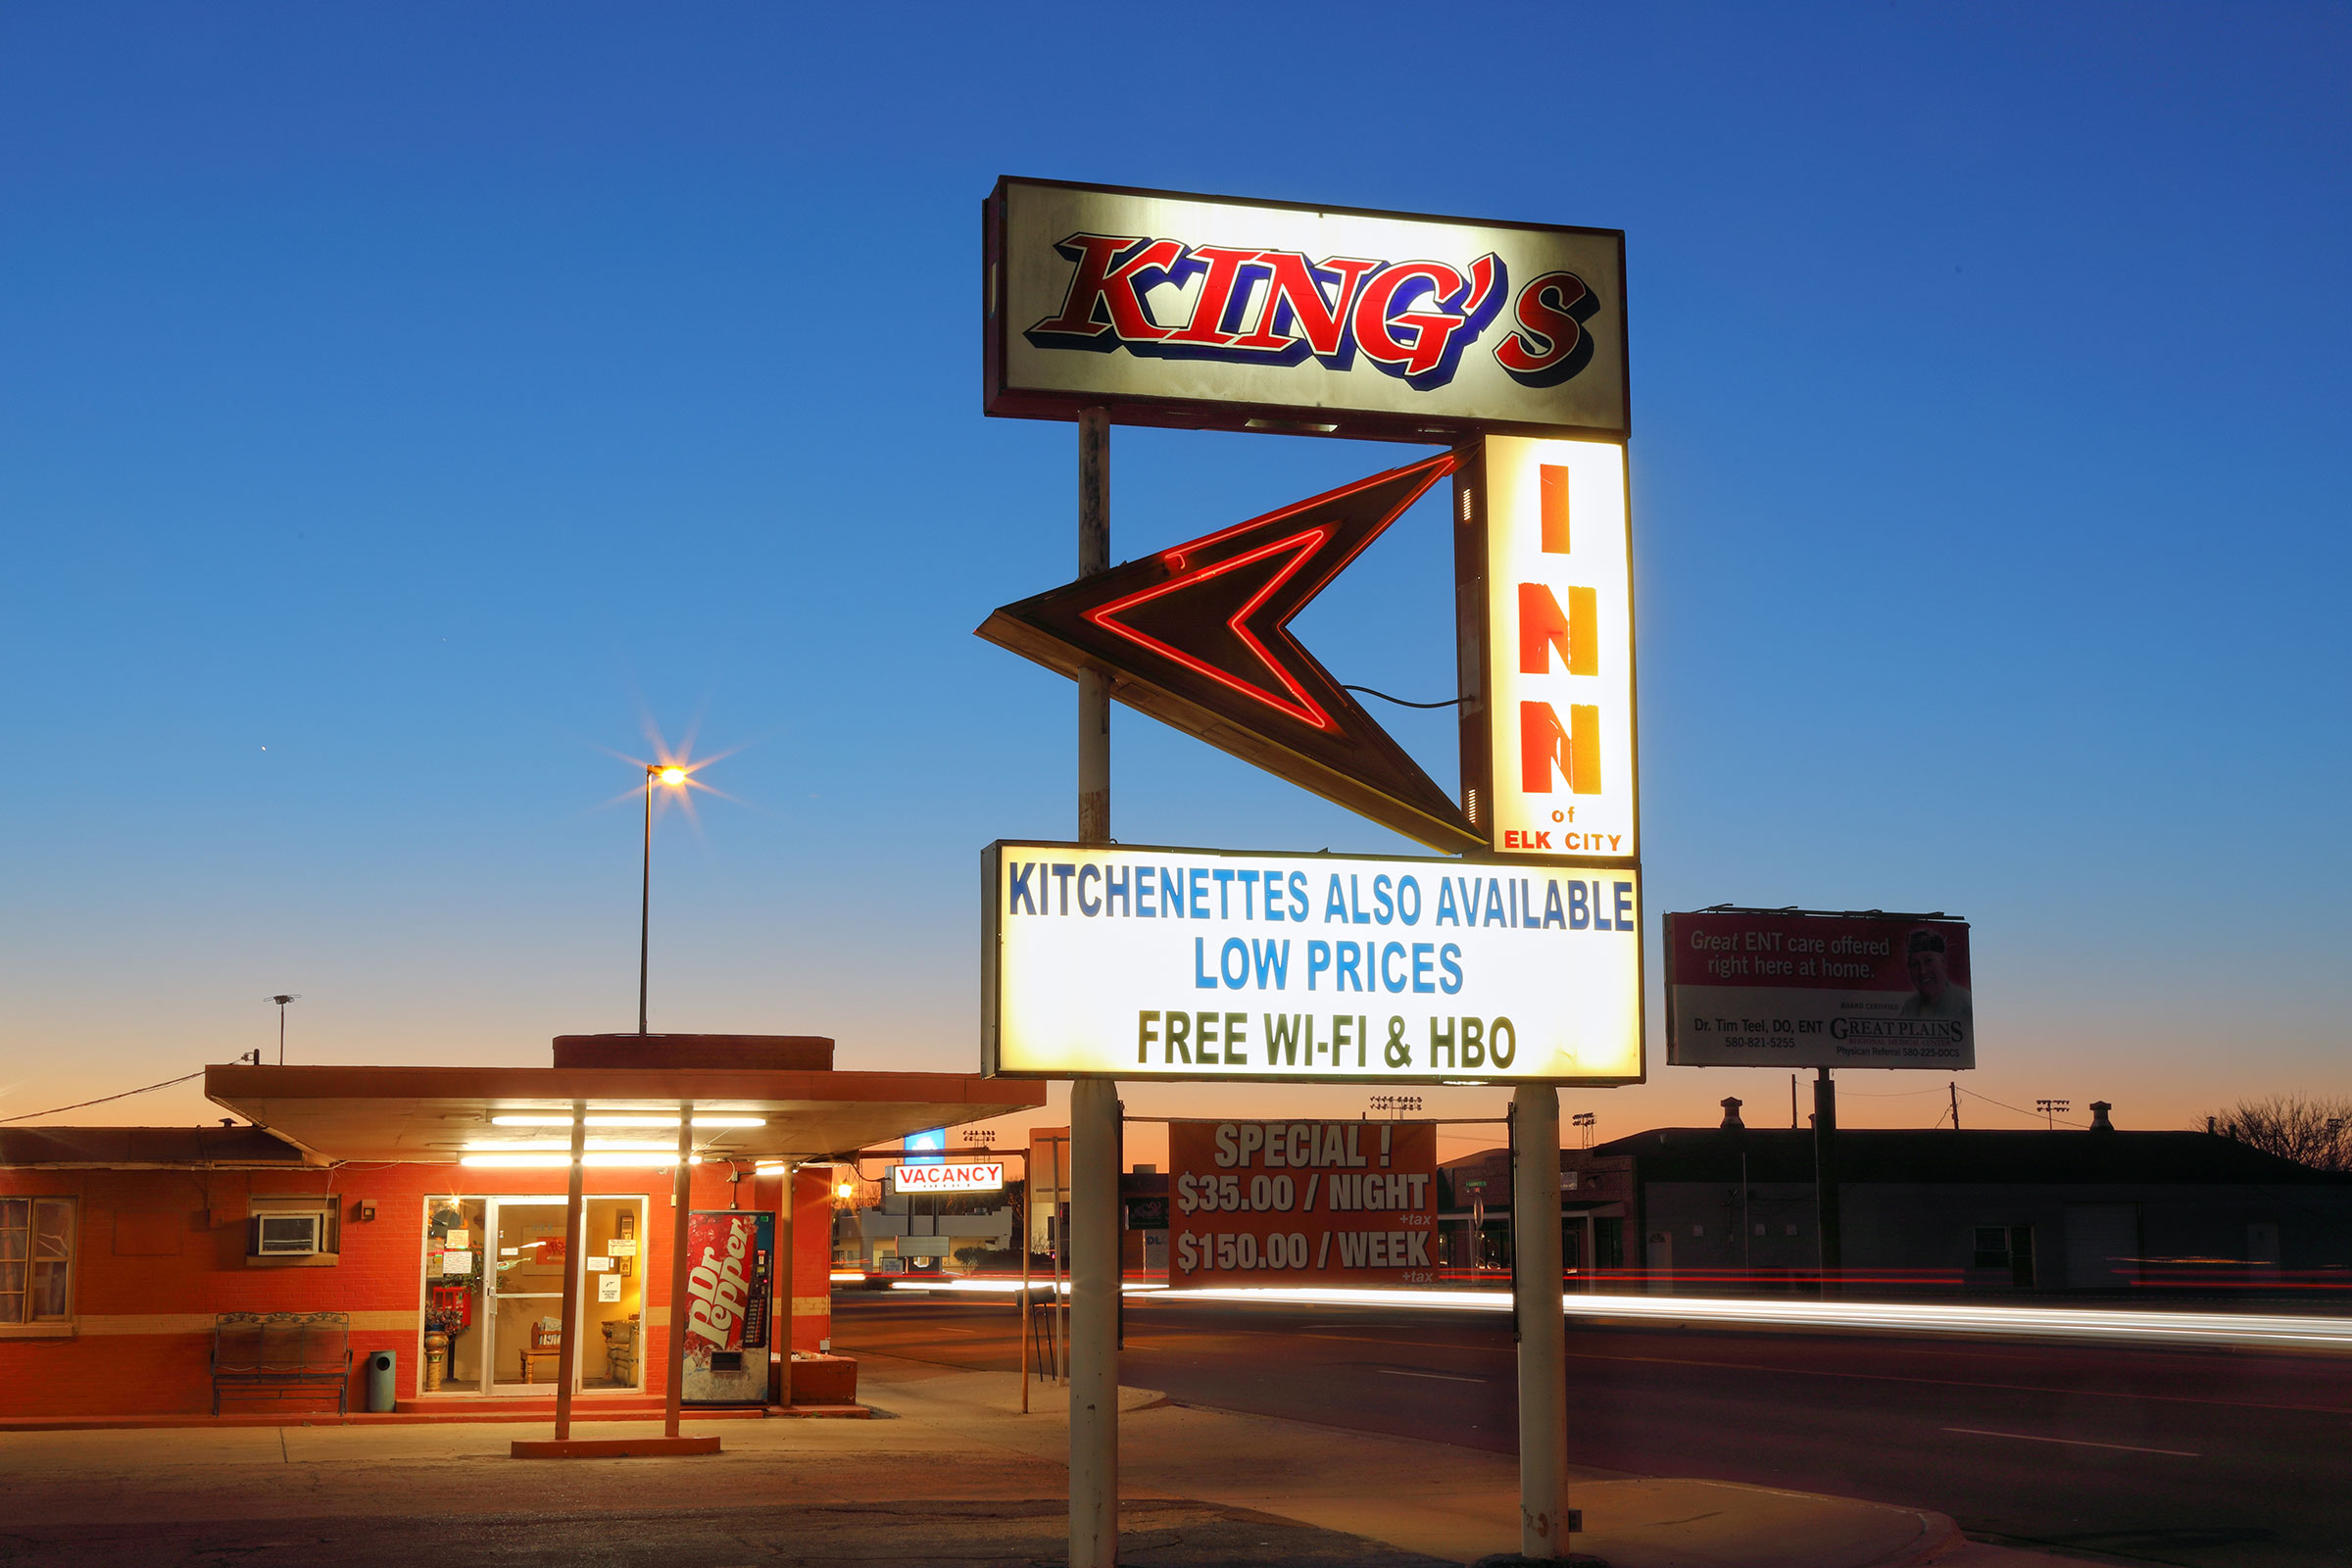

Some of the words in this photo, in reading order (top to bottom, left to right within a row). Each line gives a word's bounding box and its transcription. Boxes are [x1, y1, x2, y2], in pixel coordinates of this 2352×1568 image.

[1023, 231, 1600, 391] KING'S
[1518, 464, 1601, 795] INN
[1551, 806, 1575, 823] of
[1504, 830, 1552, 850] ELK
[1565, 832, 1622, 852] CITY
[1009, 861, 1309, 923] KITCHENETTES
[1324, 873, 1422, 926] ALSO
[1435, 876, 1635, 932] AVAILABLE
[1690, 930, 1740, 952] Great
[1745, 931, 1783, 952] ENT
[1788, 937, 1825, 953] care
[1831, 935, 1890, 956] offered
[1195, 936, 1291, 991] LOW
[1307, 941, 1463, 995] PRICES
[1708, 954, 1748, 978] right
[1755, 956, 1792, 975] here
[1799, 958, 1816, 976] at
[1823, 957, 1875, 978] home.
[1138, 1009, 1249, 1065] FREE
[1263, 1012, 1367, 1068] WI-FI
[1384, 1014, 1413, 1068] &
[1430, 1015, 1516, 1070] HBO
[1694, 1017, 1711, 1032] Dr.
[1715, 1018, 1739, 1032] Tim
[1741, 1018, 1769, 1034] Teel,
[1773, 1019, 1794, 1035] DO,
[1798, 1020, 1824, 1033] ENT
[1725, 1036, 1795, 1049] 580-821-5255
[1830, 1017, 1896, 1040] GREAT
[1898, 1020, 1964, 1043] PLAINS
[1214, 1124, 1368, 1168] SPECIAL
[900, 1165, 1001, 1184] VACANCY
[1177, 1171, 1296, 1216] $35.00
[1303, 1174, 1320, 1211] /
[1329, 1173, 1430, 1211] NIGHT
[1398, 1213, 1432, 1225] +tax
[1177, 1230, 1309, 1275] $150.00
[1317, 1231, 1331, 1269] /
[1338, 1230, 1432, 1269] WEEK
[687, 1246, 723, 1305] Dr
[688, 1217, 750, 1350] Pepper
[1402, 1270, 1434, 1283] +tax
